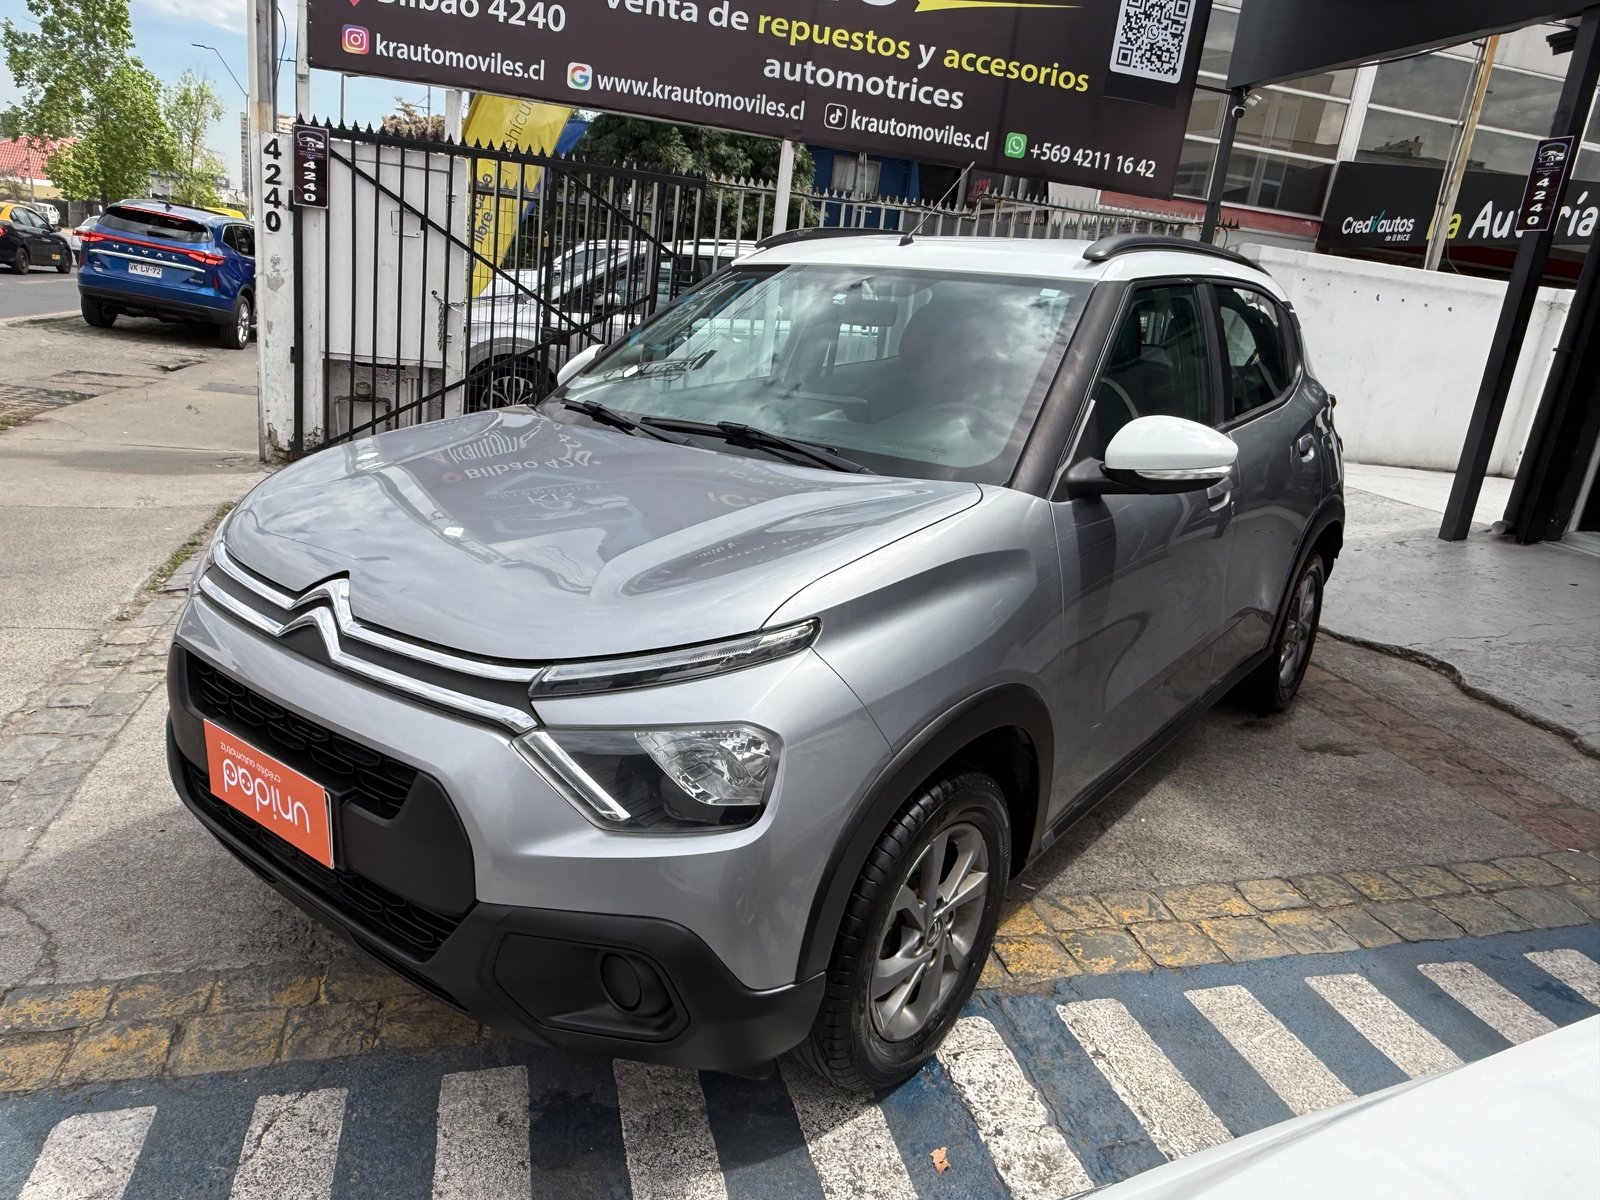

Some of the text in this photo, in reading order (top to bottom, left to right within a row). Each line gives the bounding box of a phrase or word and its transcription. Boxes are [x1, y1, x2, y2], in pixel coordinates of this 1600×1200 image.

[487, 0, 566, 33] 4240
[375, 32, 545, 81] krautomoviles.cl
[708, 0, 749, 31] de
[758, 14, 911, 60] repuestos
[917, 43, 937, 70] y
[943, 49, 1089, 92] accesorios
[597, 74, 806, 121] www.krautomoviles.cl
[763, 58, 964, 110] automotrices
[850, 108, 990, 151] krautomoviles.cl
[1030, 142, 1156, 178] +569 4211 16 42
[263, 137, 283, 233] 4240
[1526, 177, 1550, 225] 4240
[222, 758, 311, 834] unidad
